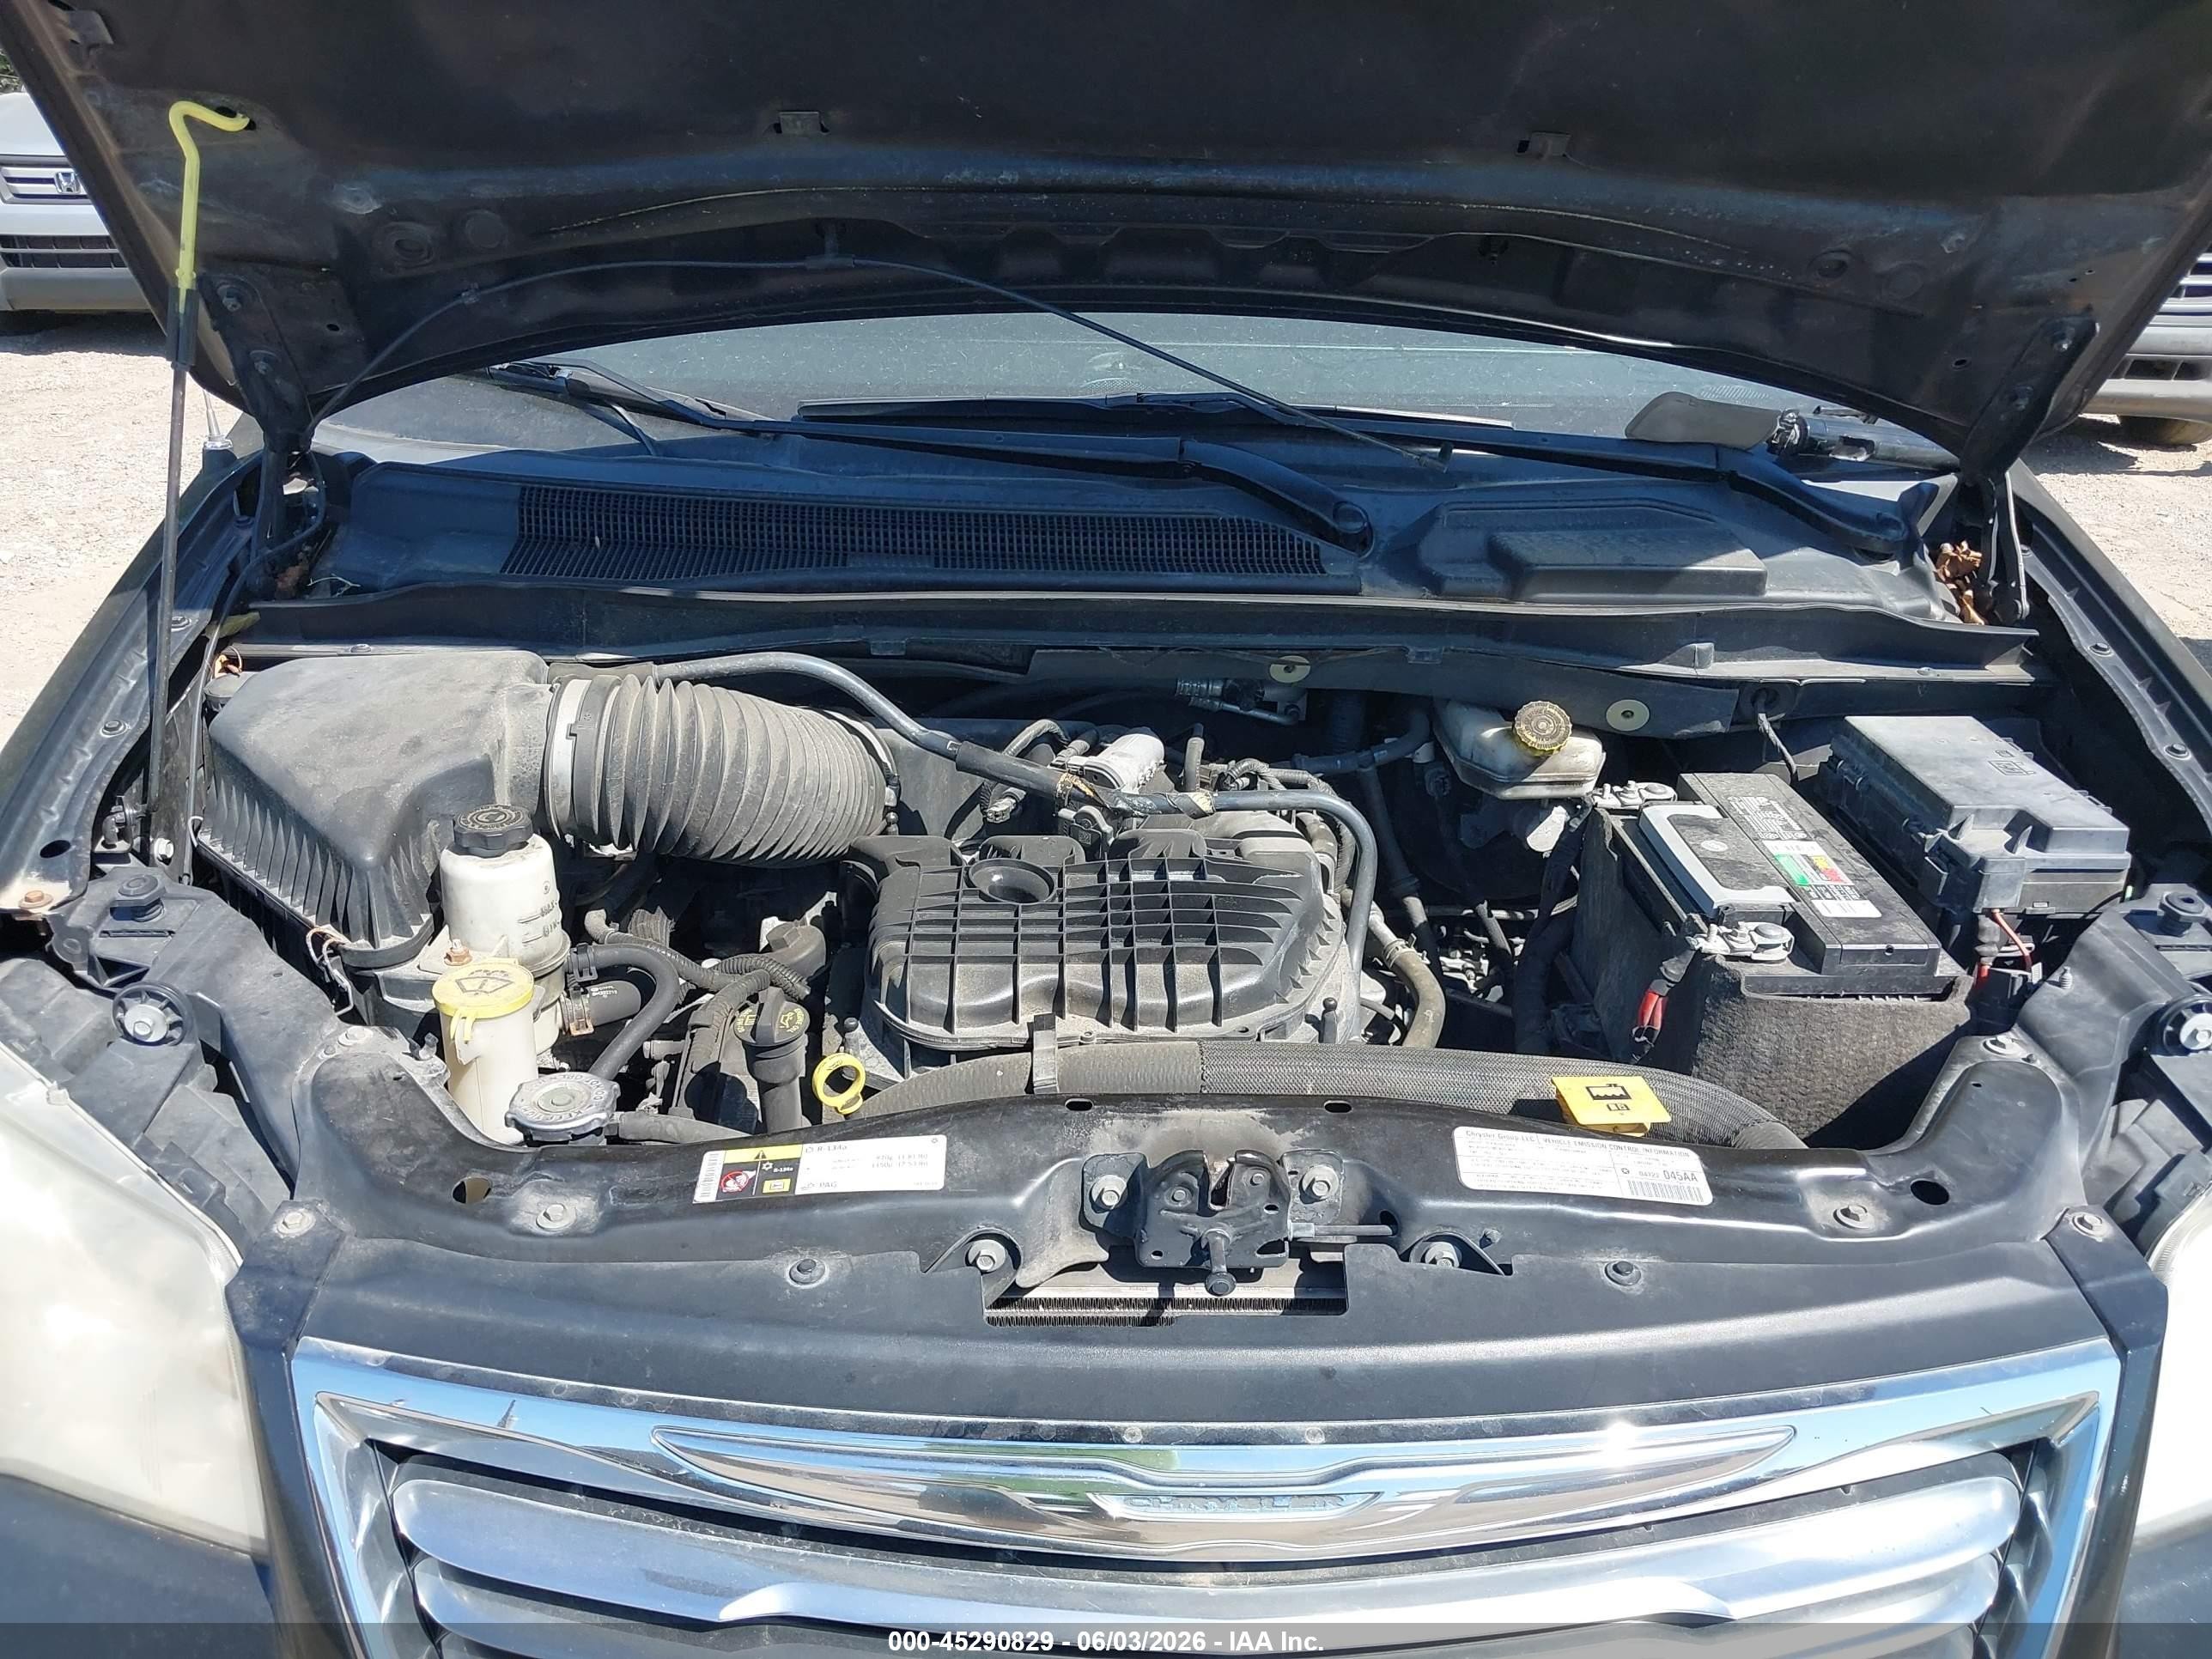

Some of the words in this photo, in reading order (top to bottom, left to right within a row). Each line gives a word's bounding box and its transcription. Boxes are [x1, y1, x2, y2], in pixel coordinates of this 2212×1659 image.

[1466, 1129, 1495, 1139] Chrysler
[1498, 1133, 1519, 1141] Group
[1522, 1134, 1536, 1143] LLC
[1542, 1137, 1571, 1146] VEHICLE
[1573, 1140, 1607, 1151] EMISSION
[1608, 1144, 1639, 1152] CONTROL
[1643, 1146, 1691, 1158] INFORMATION
[1662, 1170, 1698, 1182] 045AA
